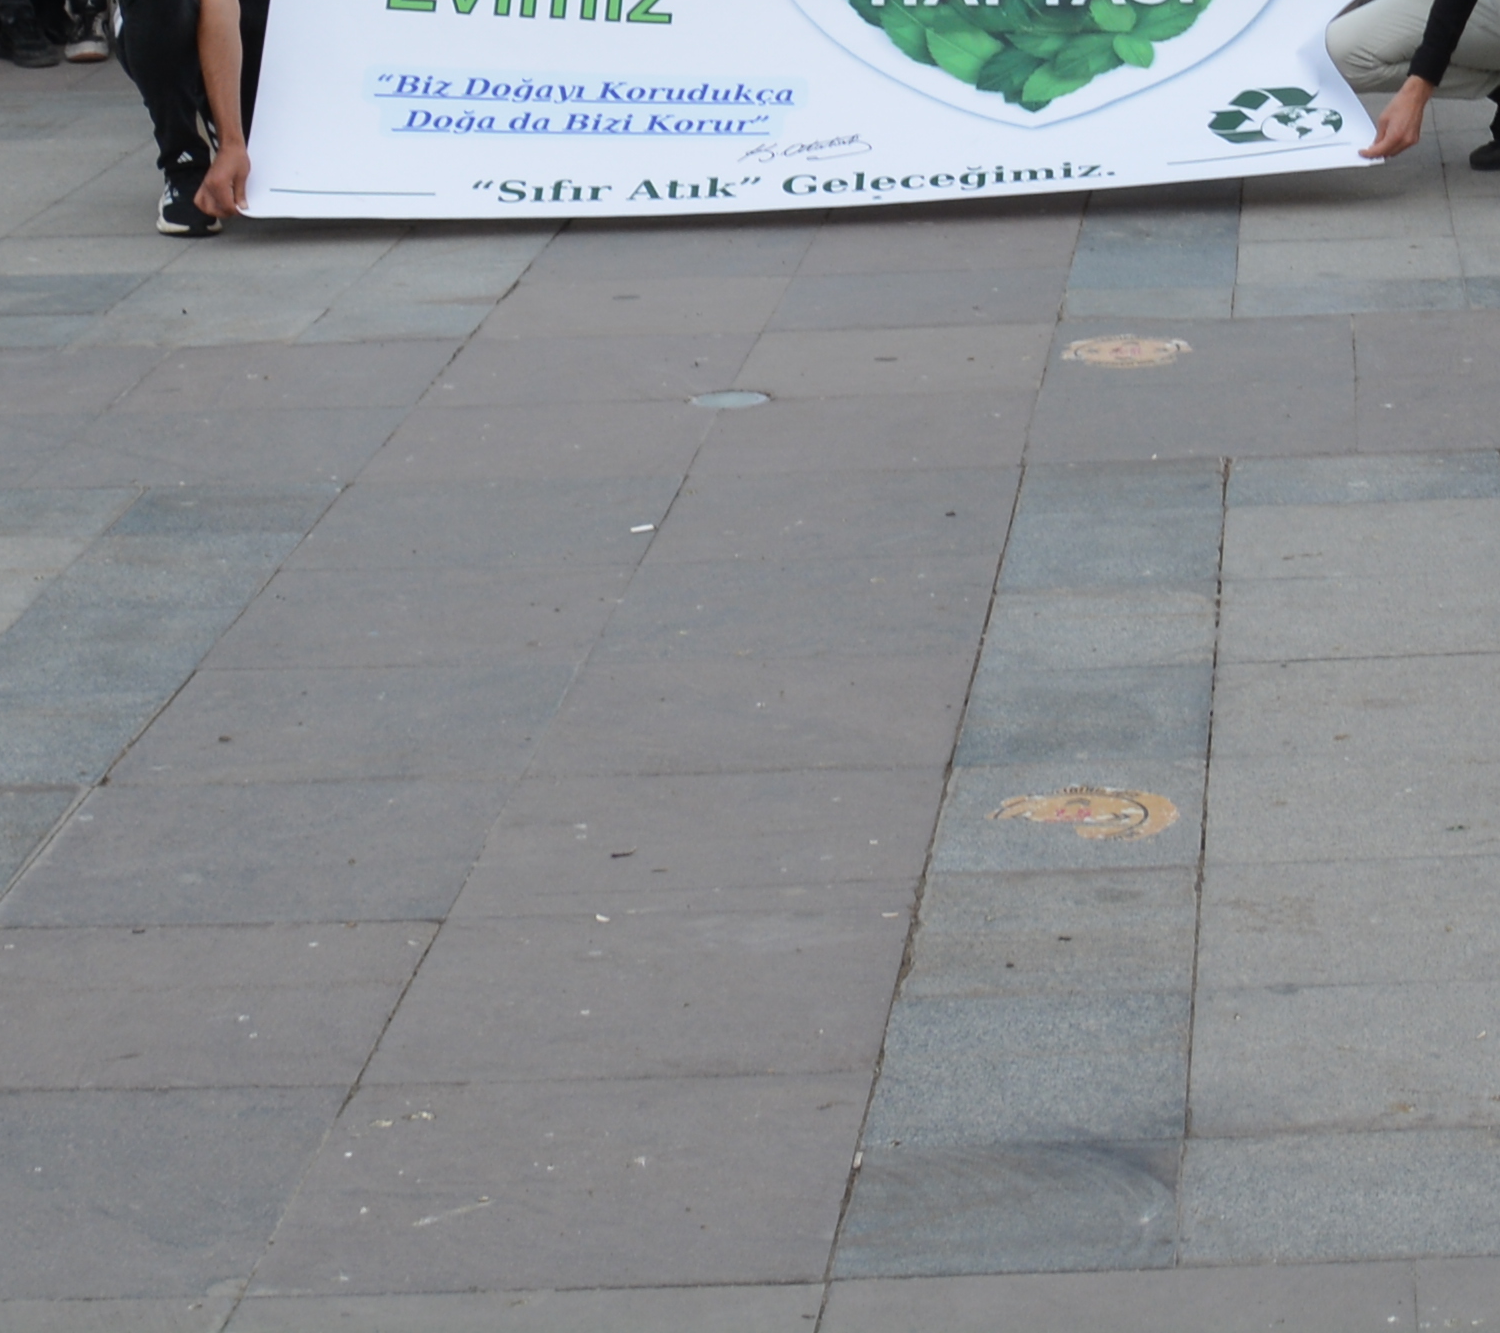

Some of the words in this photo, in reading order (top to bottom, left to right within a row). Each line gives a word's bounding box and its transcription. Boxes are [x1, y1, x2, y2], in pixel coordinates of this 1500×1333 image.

[464, 76, 586, 105] Doğayı
[598, 80, 794, 106] Korudukça
[404, 109, 496, 134] Doğa
[508, 111, 551, 133] da
[564, 113, 633, 134] Bizi
